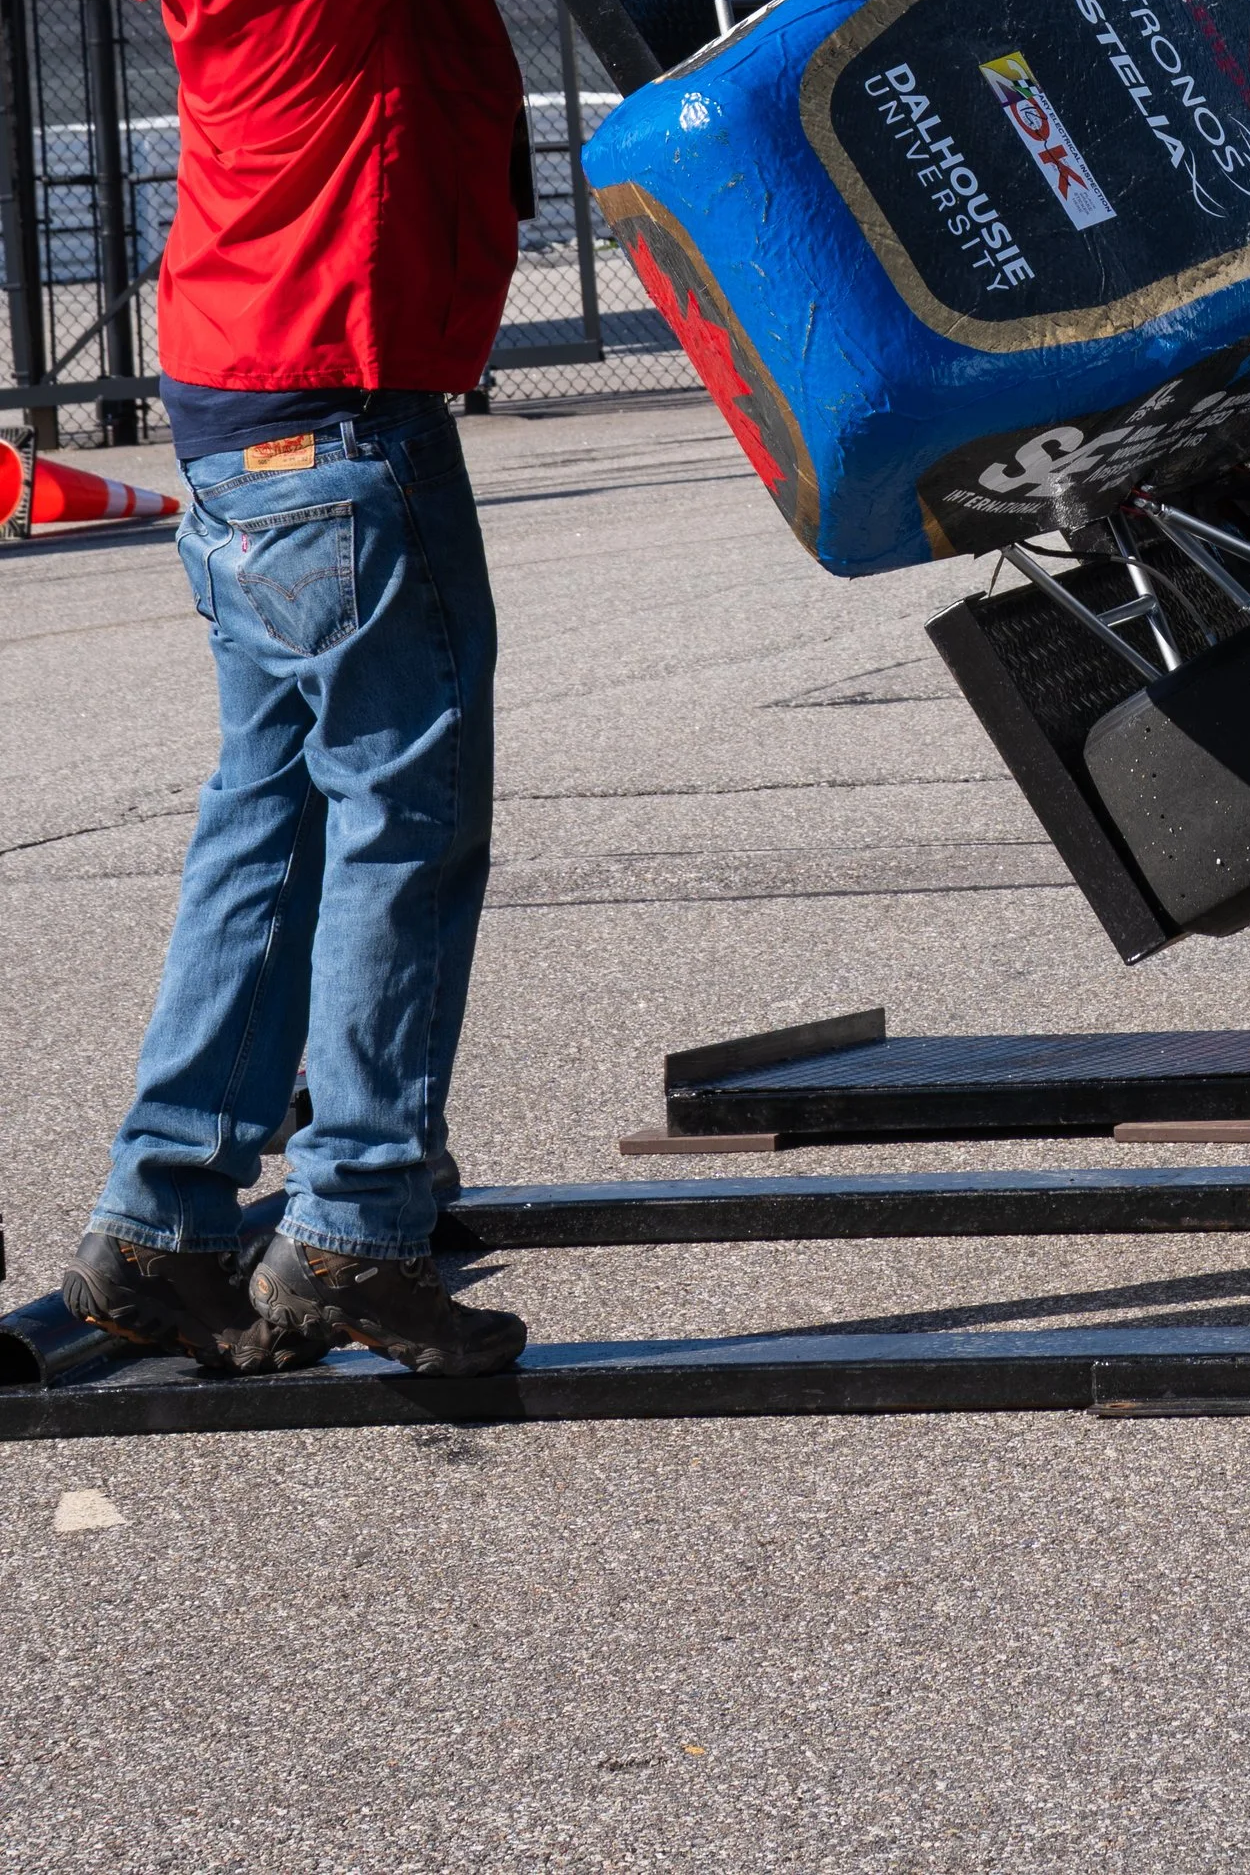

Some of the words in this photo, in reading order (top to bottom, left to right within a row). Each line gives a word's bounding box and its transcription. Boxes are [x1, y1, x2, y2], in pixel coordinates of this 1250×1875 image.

[864, 74, 1010, 291] UNIVERSITY
[885, 62, 1035, 286] DALHOUSIE
[1009, 96, 1090, 202] OK
[1050, 111, 1083, 164] ELECTRICAL
[1079, 164, 1112, 213] INSPECTION
[942, 488, 1051, 515] INTERNATIONAL
